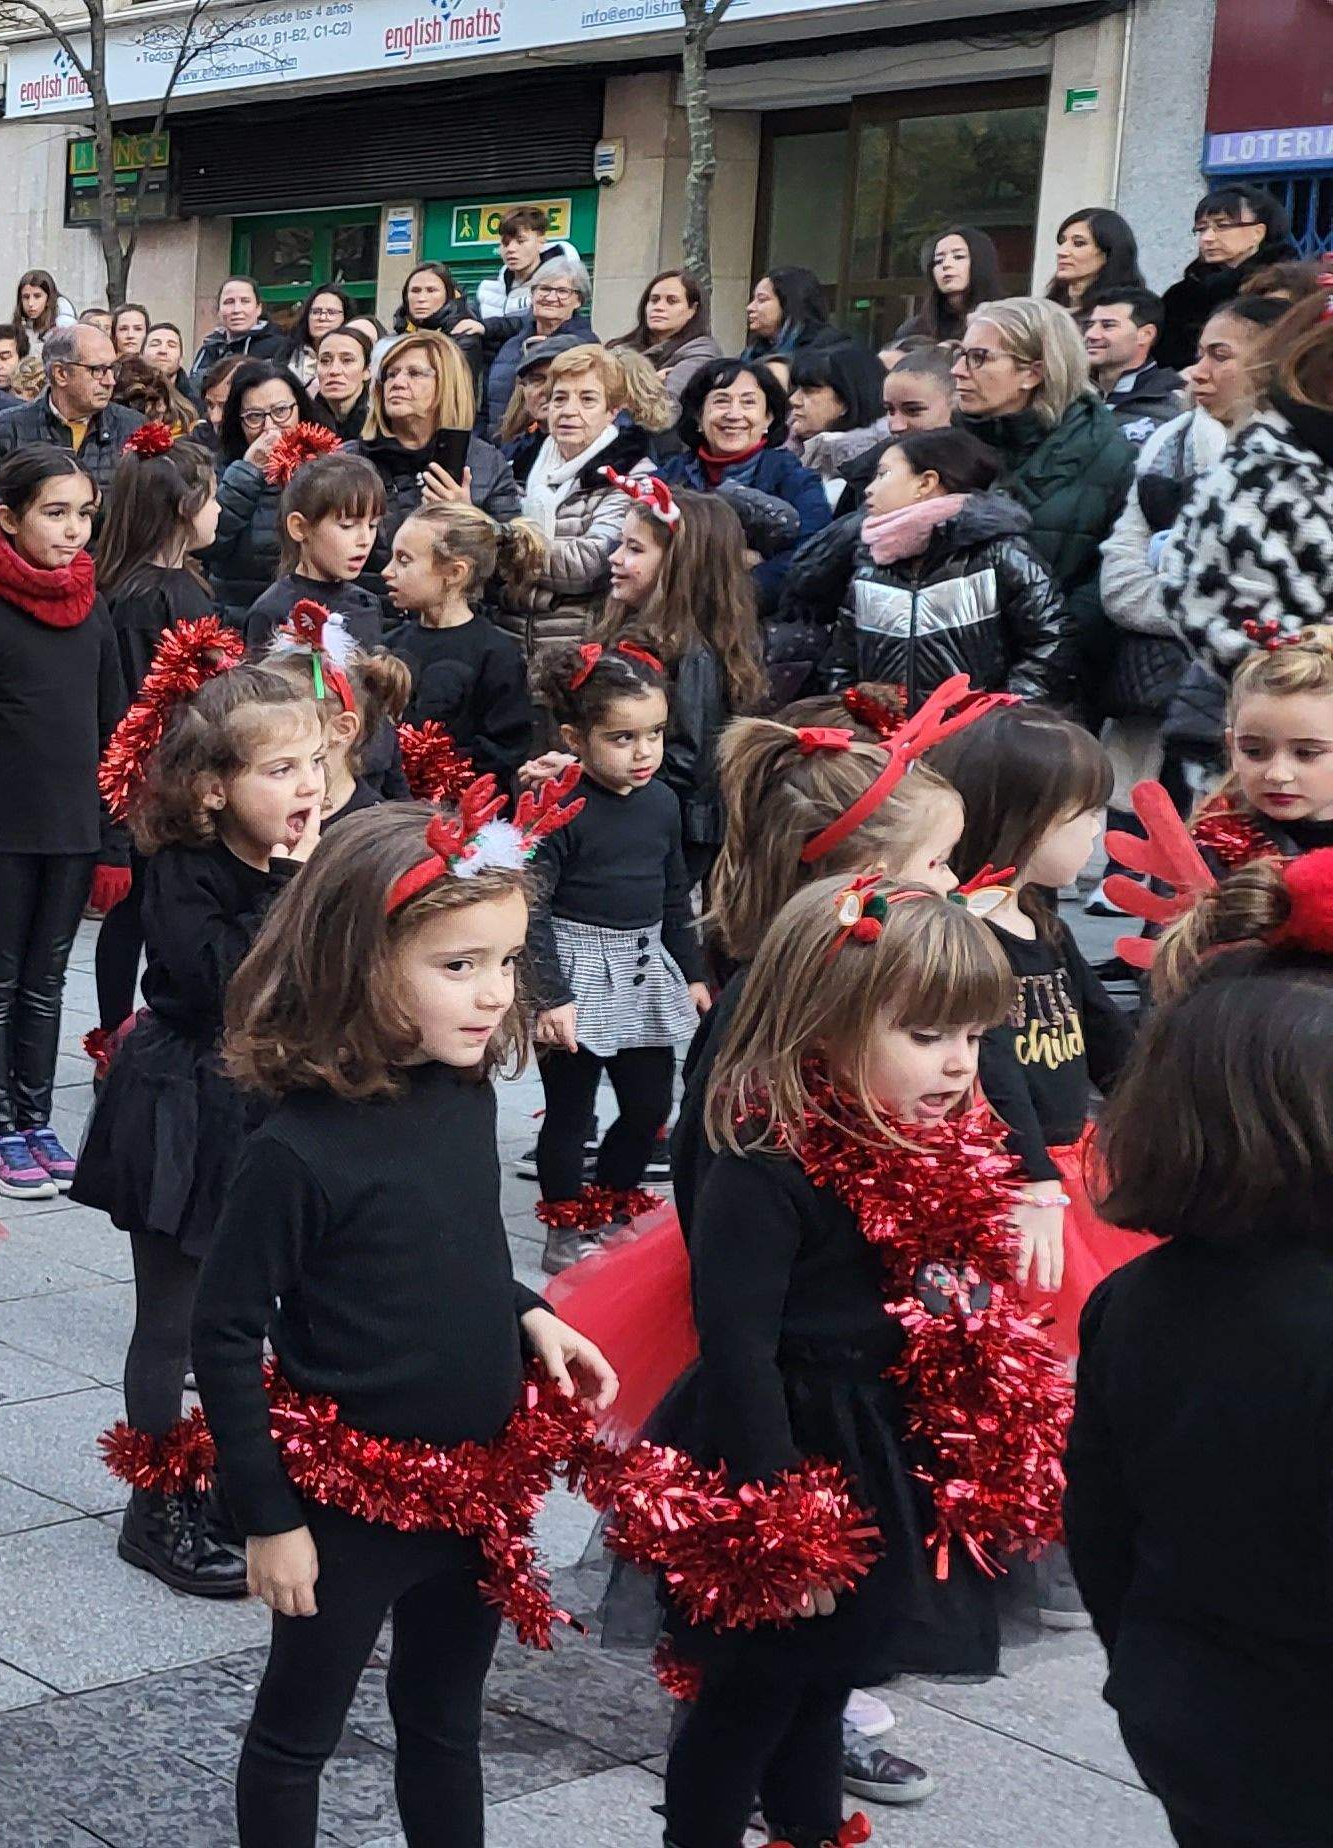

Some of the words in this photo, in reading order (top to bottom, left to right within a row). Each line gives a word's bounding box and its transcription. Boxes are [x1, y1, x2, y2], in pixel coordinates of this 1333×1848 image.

[259, 12, 293, 27] desde
[296, 8, 313, 21] los
[316, 5, 323, 17] 4
[384, 14, 442, 60] english
[449, 7, 502, 41] maths
[143, 50, 174, 63] Todos
[313, 21, 352, 39] C1-C2)
[20, 73, 62, 111] english
[486, 207, 562, 237] OE
[1015, 1010, 1086, 1070] child
